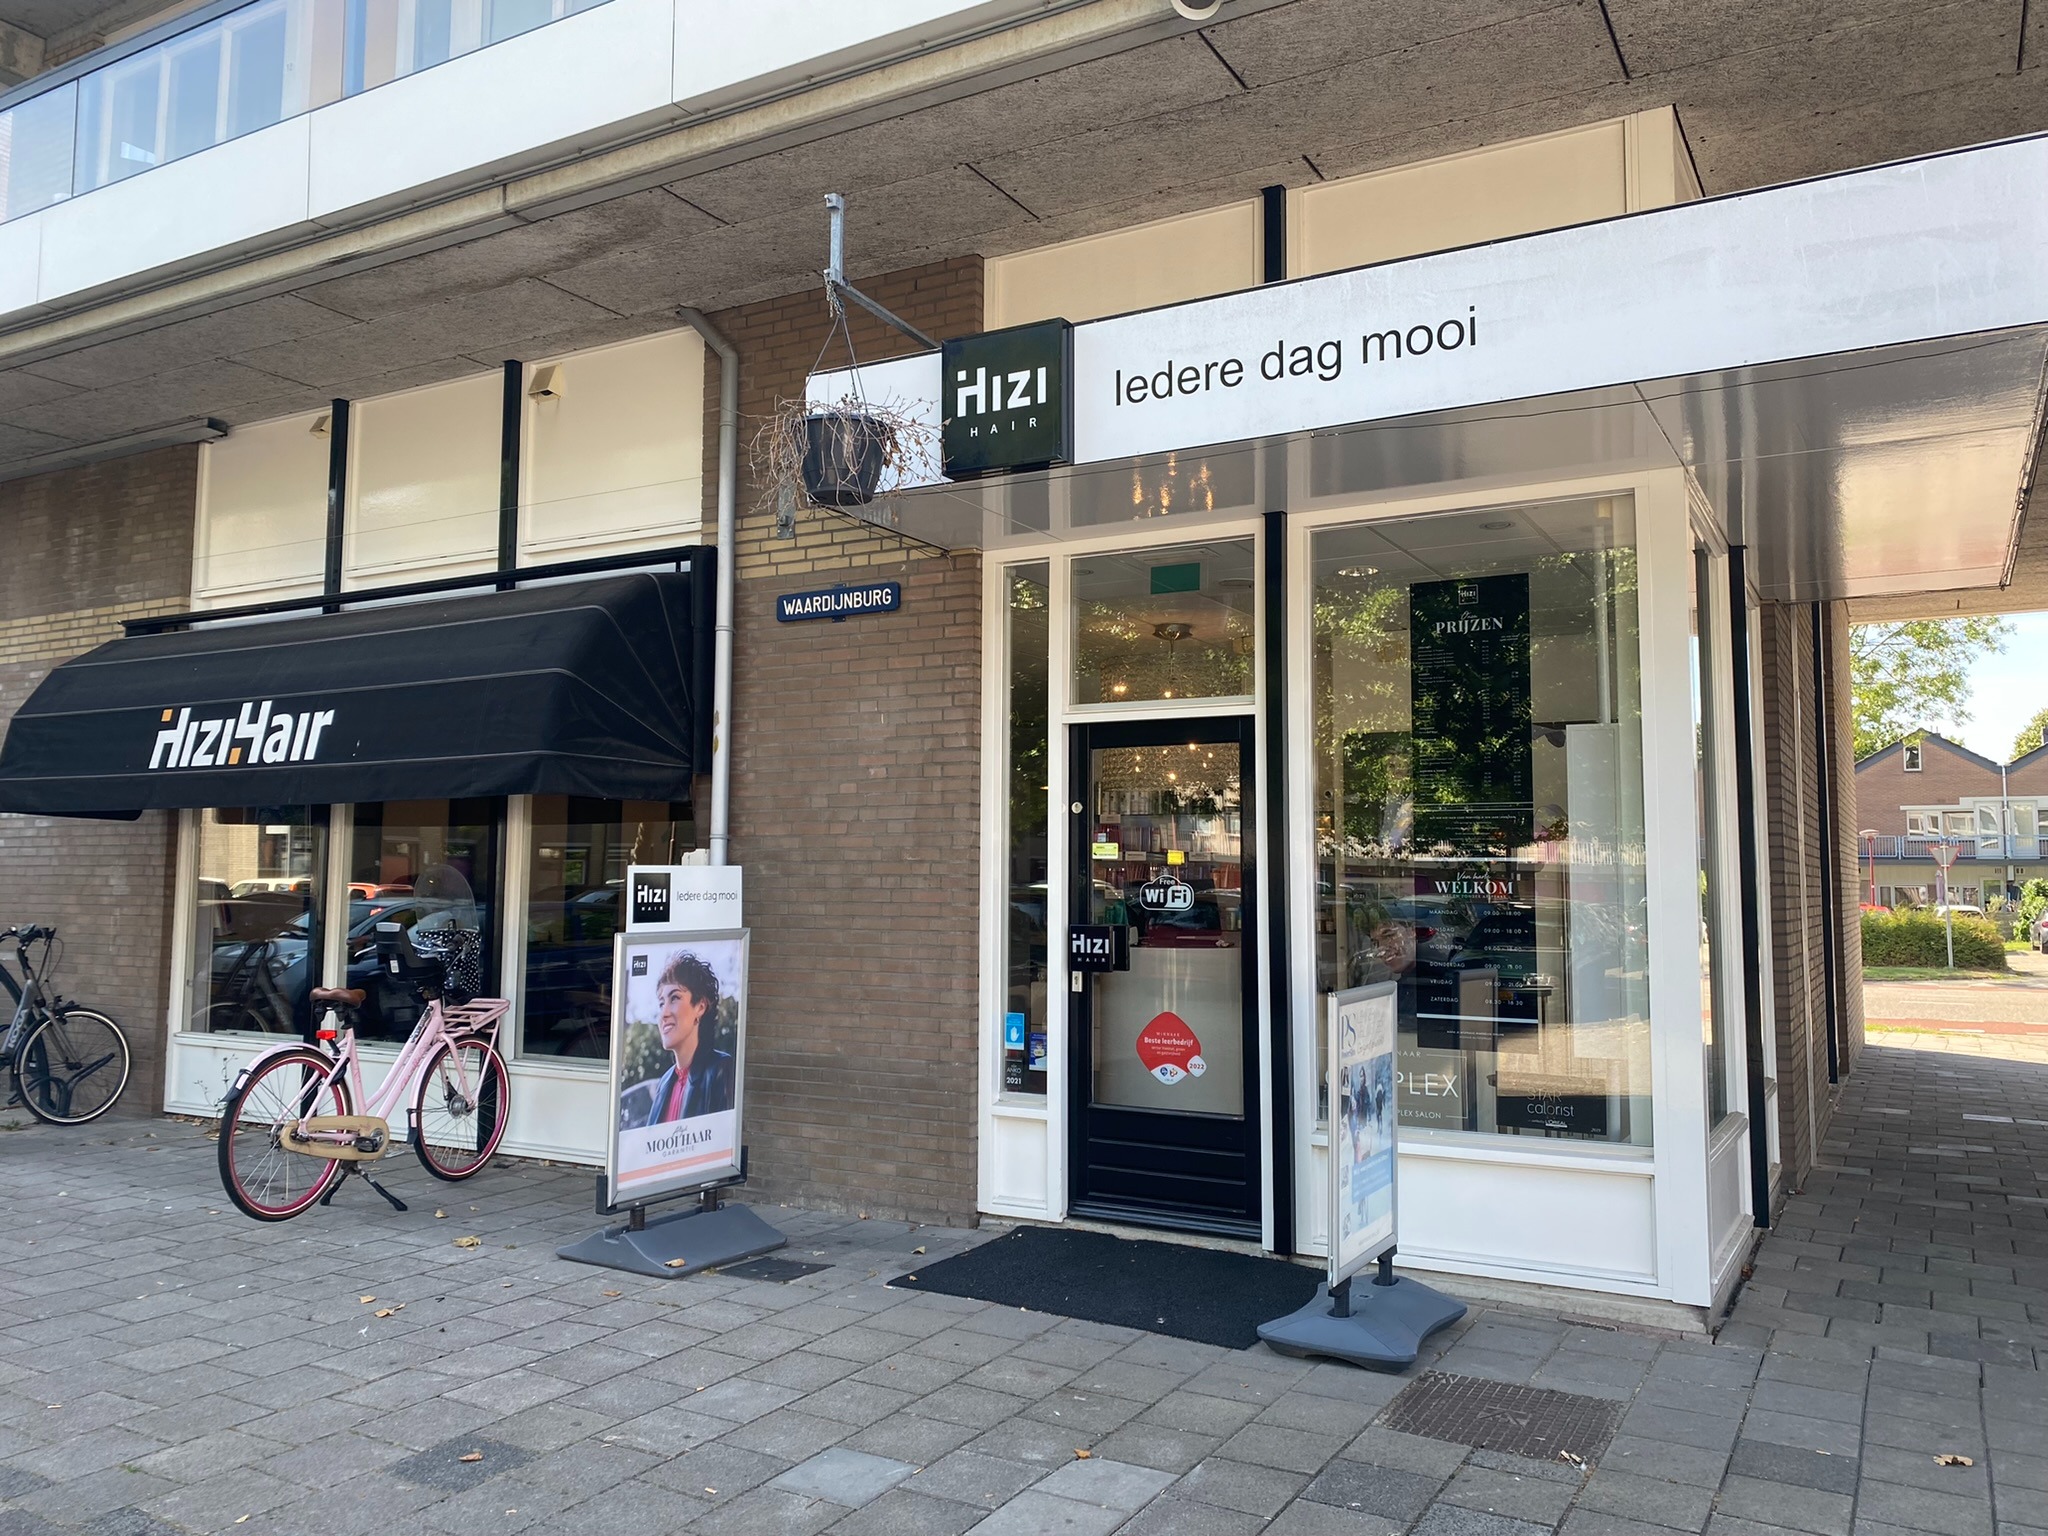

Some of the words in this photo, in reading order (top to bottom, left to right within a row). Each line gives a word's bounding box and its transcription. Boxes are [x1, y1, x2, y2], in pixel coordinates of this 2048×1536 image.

[1115, 360, 1244, 406] Iedere
[1260, 339, 1342, 381] dag
[1362, 306, 1477, 364] mooi
[969, 417, 1037, 438] HAIR
[783, 588, 892, 616] WAARDIJNBURG
[1435, 616, 1504, 635] PRIJZEN
[1159, 878, 1176, 886] Free
[1434, 881, 1514, 895] WELKOM
[637, 885, 667, 903] HIZI
[676, 890, 701, 901] Iedere
[702, 890, 717, 904] dag
[718, 891, 738, 901] mooi
[1072, 933, 1110, 954] HIZI
[8, 1009, 29, 1048] KOGA
[1144, 1036, 1161, 1044] Beste
[1161, 1037, 1194, 1047] leerbedrijf
[1006, 1076, 1022, 1085] 2021
[1527, 1086, 1562, 1103] STAR
[1415, 1110, 1442, 1119] SALON
[646, 1135, 678, 1153] MOOI
[681, 1128, 712, 1146] HAAR
[662, 1145, 695, 1158] GARANTIE
